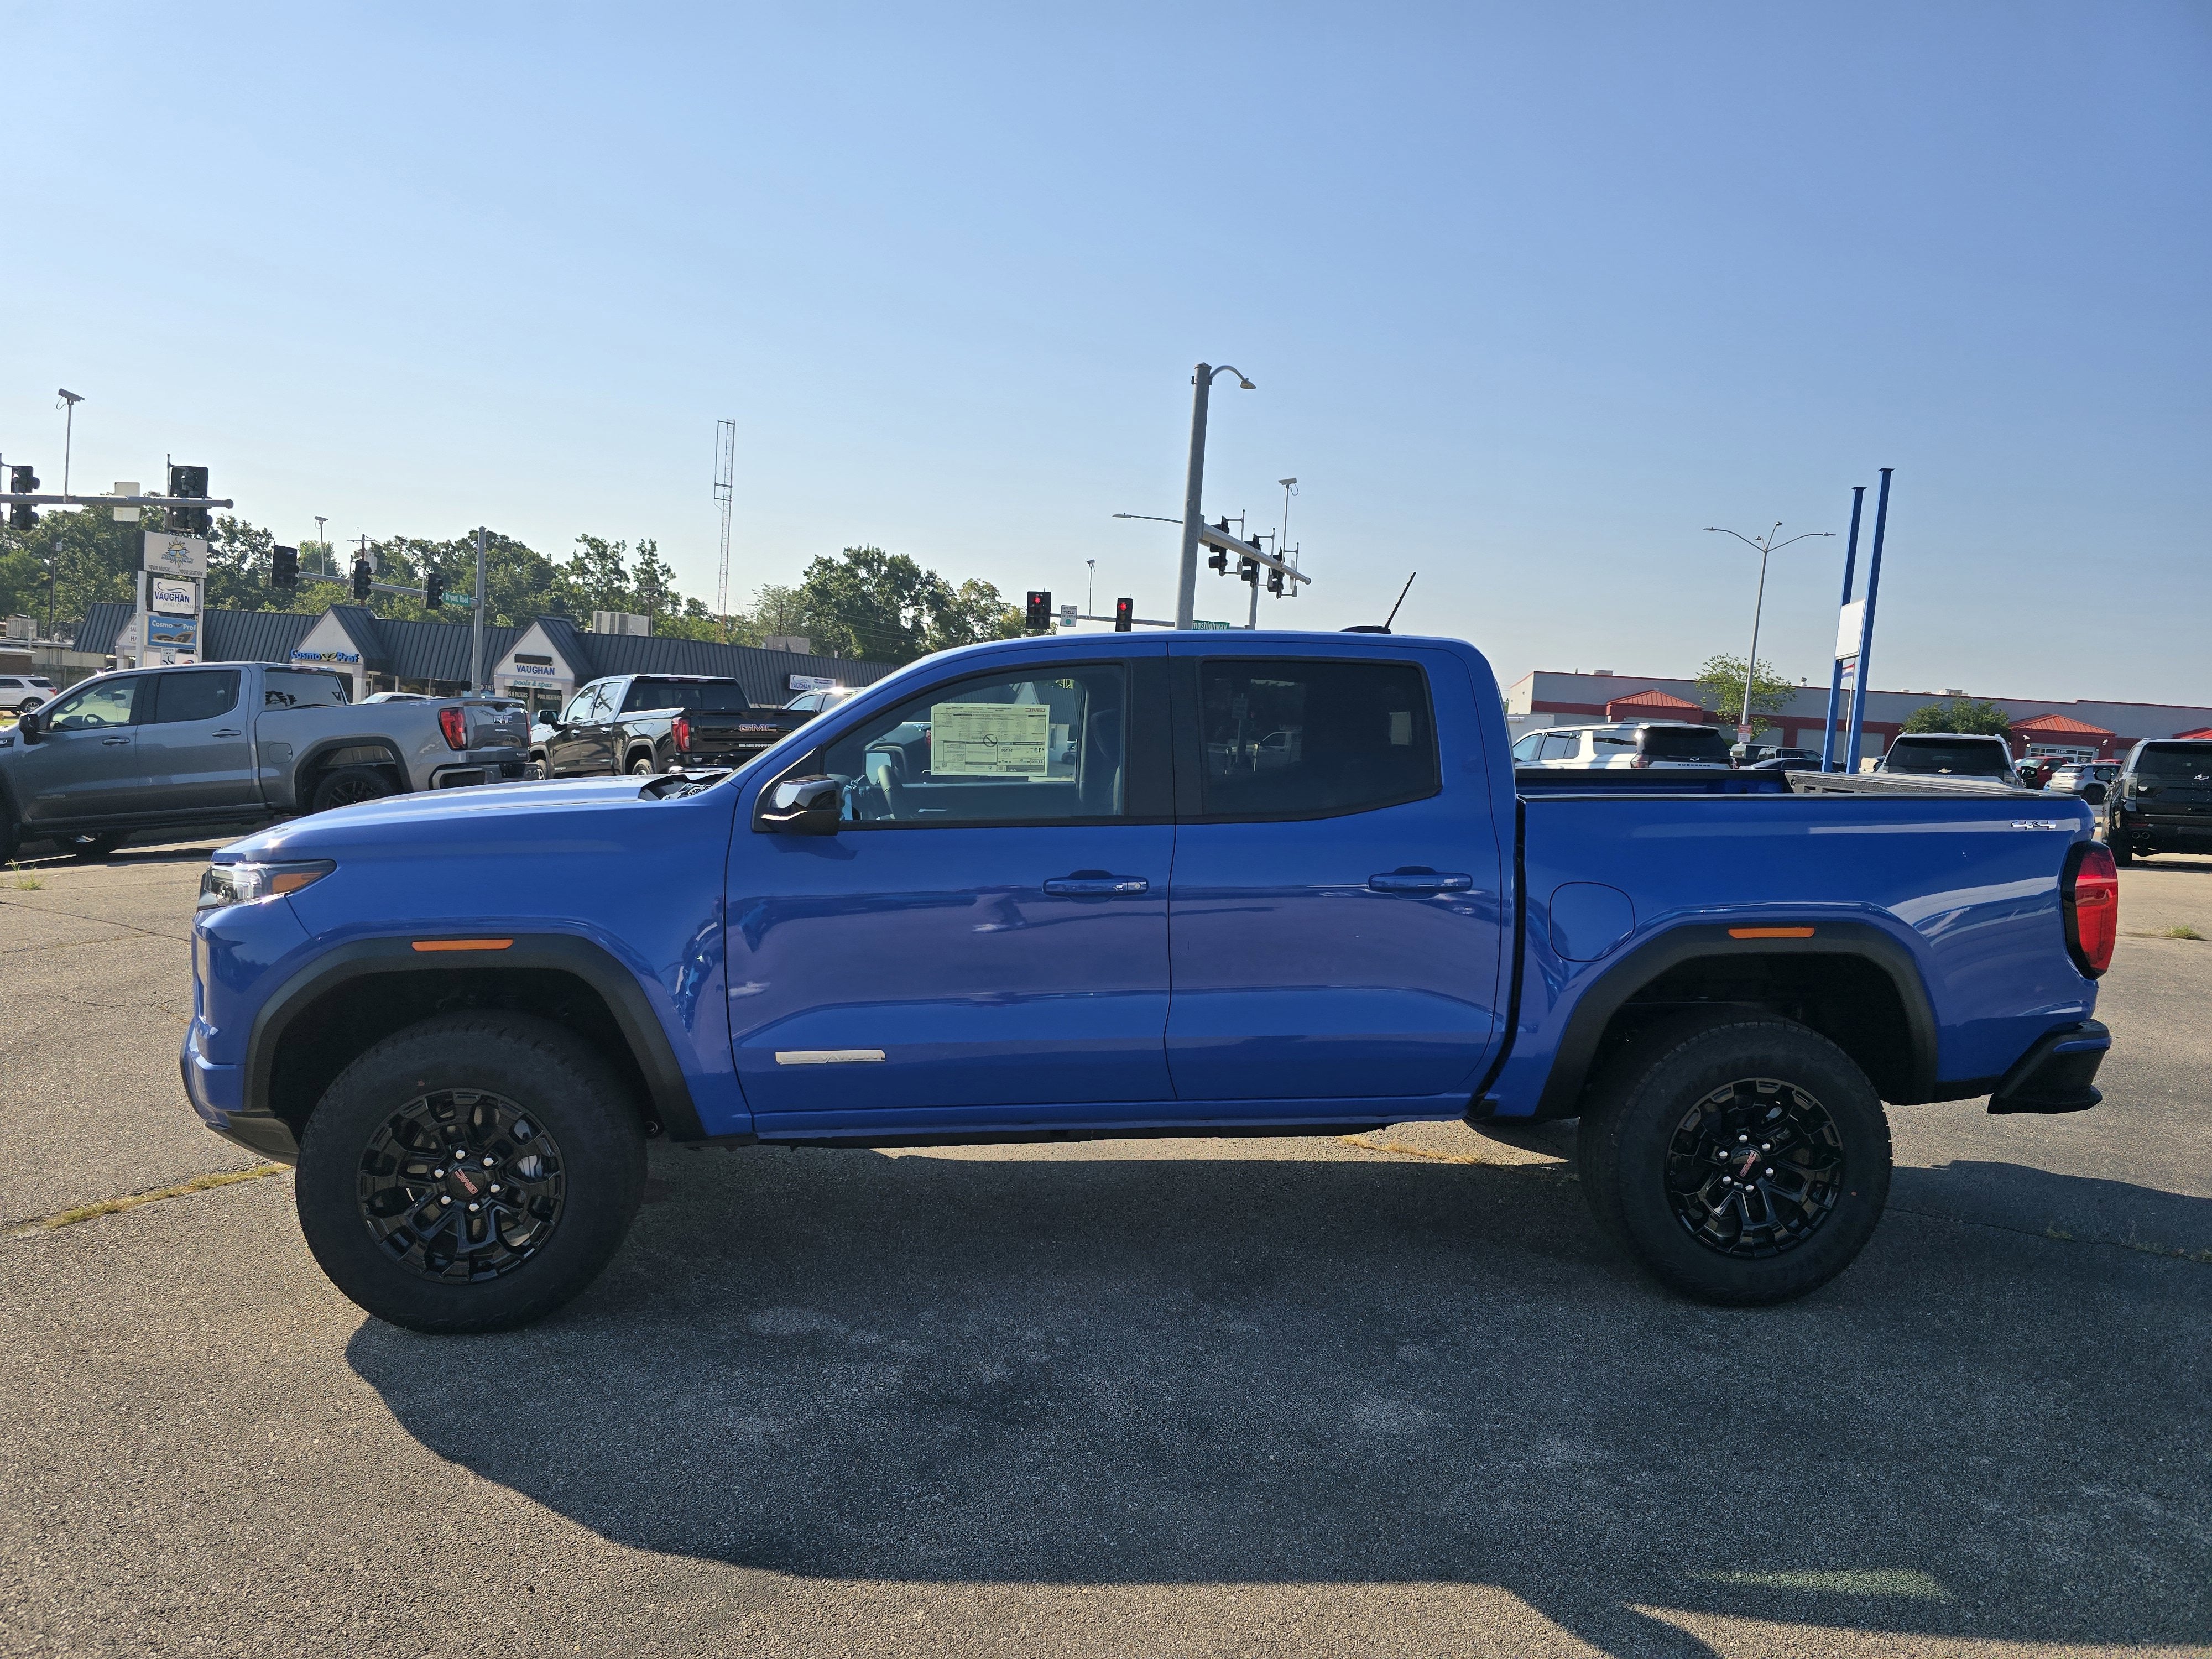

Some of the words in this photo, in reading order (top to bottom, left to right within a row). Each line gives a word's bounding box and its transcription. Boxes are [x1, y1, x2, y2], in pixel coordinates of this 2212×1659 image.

[155, 591, 190, 603] VAUGHAN
[445, 592, 458, 603] Bryant
[460, 594, 469, 604] Road
[152, 620, 173, 629] Cosmo
[1192, 622, 1228, 630] ingshighway
[290, 648, 321, 660] Cosmo
[337, 651, 359, 663] Prof
[516, 665, 555, 675] VAUGHAN
[791, 682, 811, 691] VAUGHAN
[1739, 1150, 1757, 1177] GMC
[455, 1168, 478, 1194] GMC
